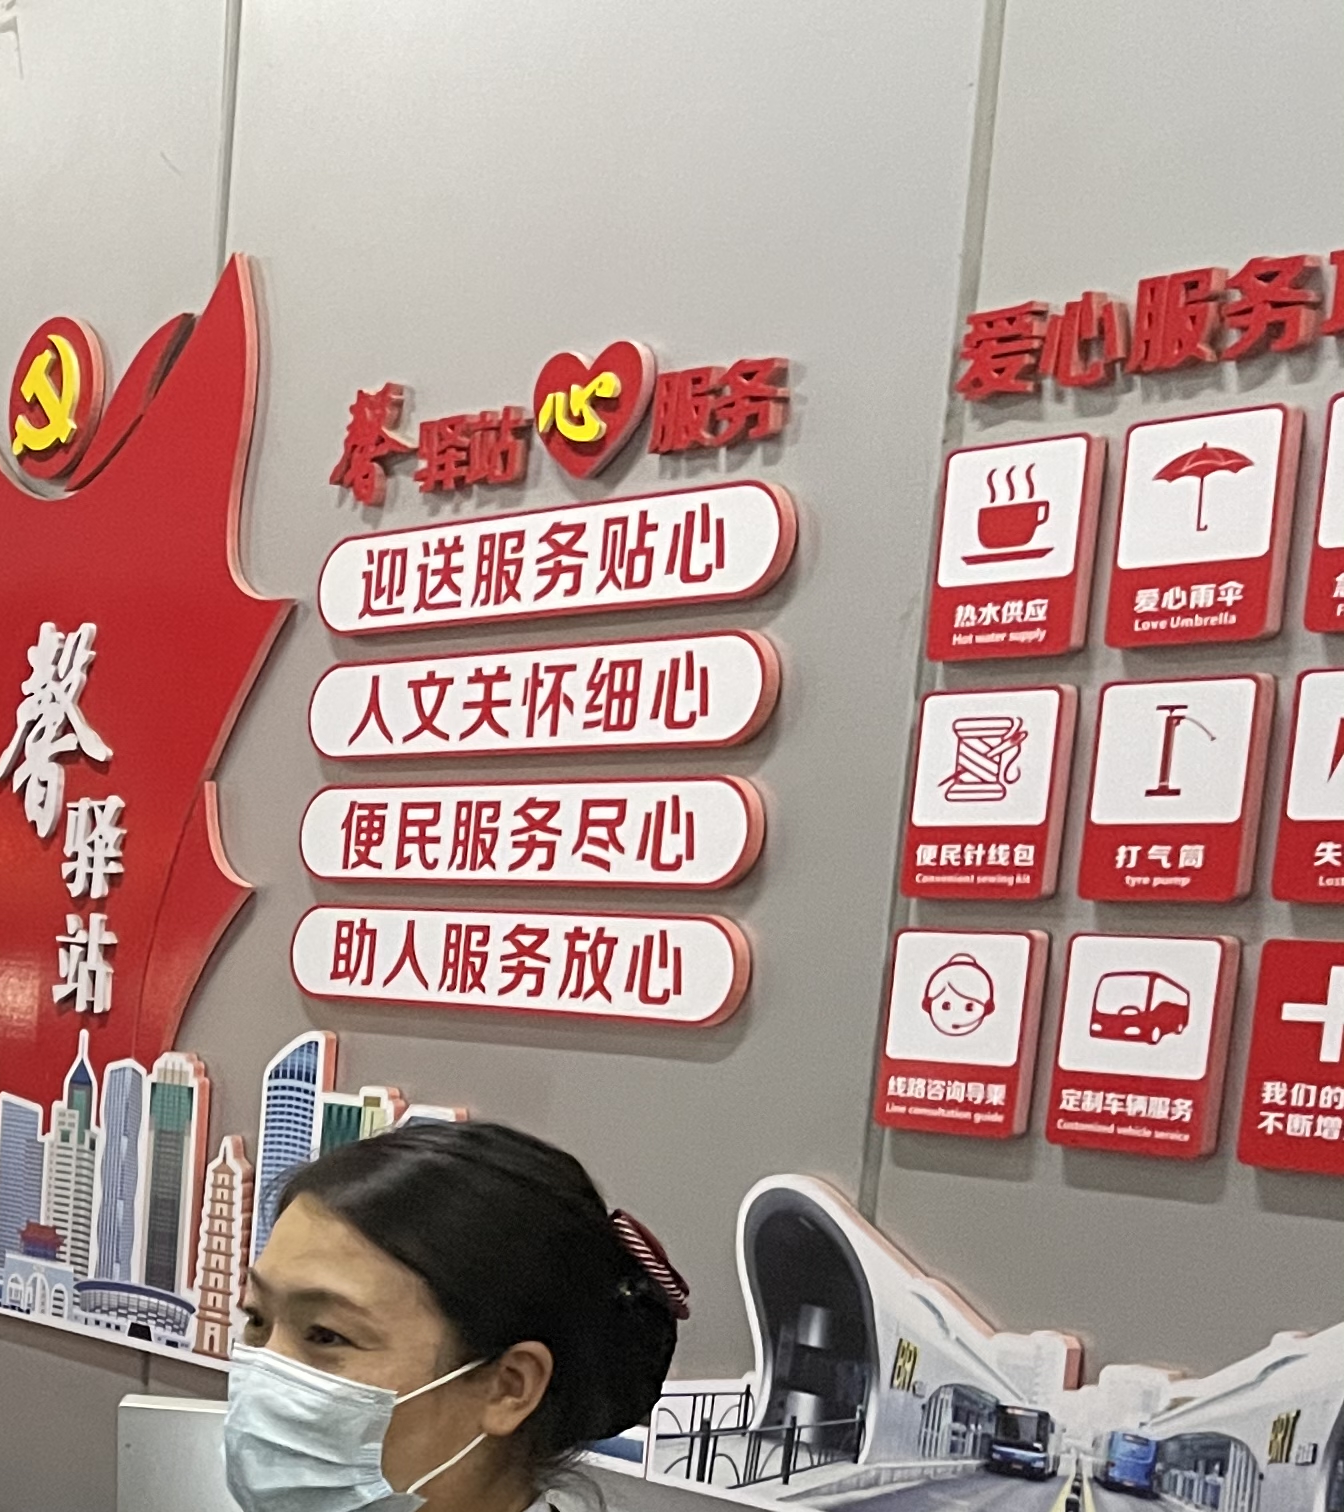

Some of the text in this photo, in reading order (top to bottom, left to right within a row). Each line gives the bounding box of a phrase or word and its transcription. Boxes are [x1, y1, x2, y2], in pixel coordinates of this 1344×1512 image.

[955, 250, 1344, 401] 爱心服务
[358, 503, 726, 620] 迎送服务贴心
[1133, 580, 1246, 614] 爱心雨伞
[953, 598, 1049, 628] 热水供应
[1133, 612, 1237, 632] Love Umbrella
[952, 633, 974, 645] Hot
[1008, 628, 1047, 643] supply
[347, 650, 710, 747] 人文关怀细心
[340, 794, 696, 873] 便民服务尽心
[915, 843, 1036, 867] 便民针线包
[1115, 844, 1206, 869] 打气筒
[1313, 841, 1343, 867] 失
[1152, 876, 1191, 888] pump
[1318, 875, 1344, 887] Los
[329, 918, 683, 1006] 助人服务放心
[1059, 1088, 1194, 1123] 定制车辆服务
[1261, 1081, 1344, 1110] 我们的
